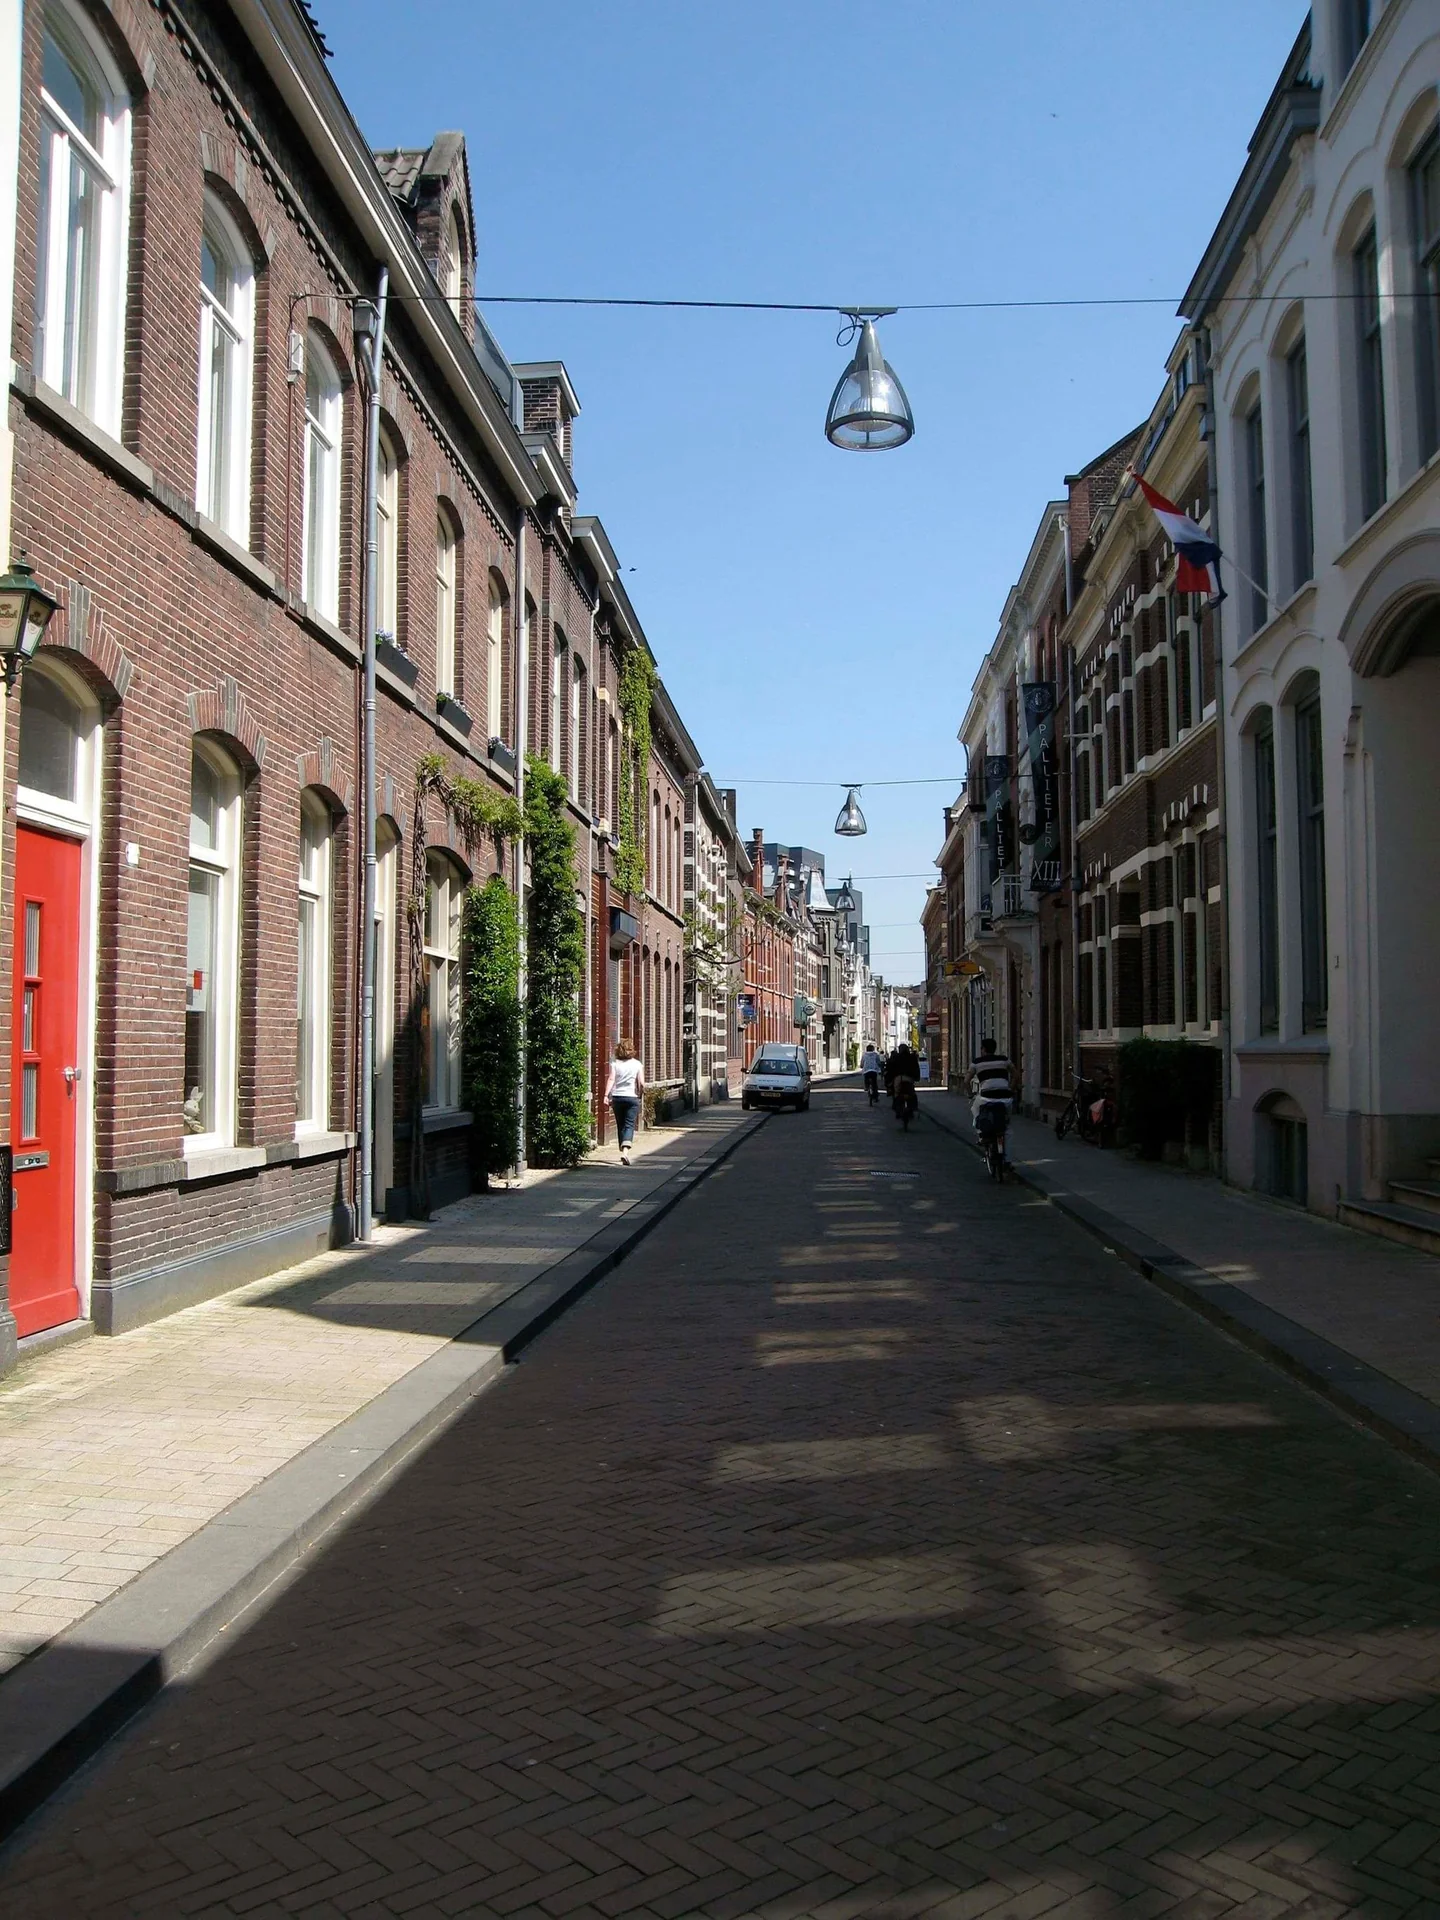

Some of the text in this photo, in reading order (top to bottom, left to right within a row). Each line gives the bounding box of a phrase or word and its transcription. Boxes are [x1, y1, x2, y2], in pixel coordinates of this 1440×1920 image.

[1038, 723, 1053, 848] PALLIETER
[994, 789, 1005, 876] PALLIETE
[1032, 860, 1061, 881] XIII
